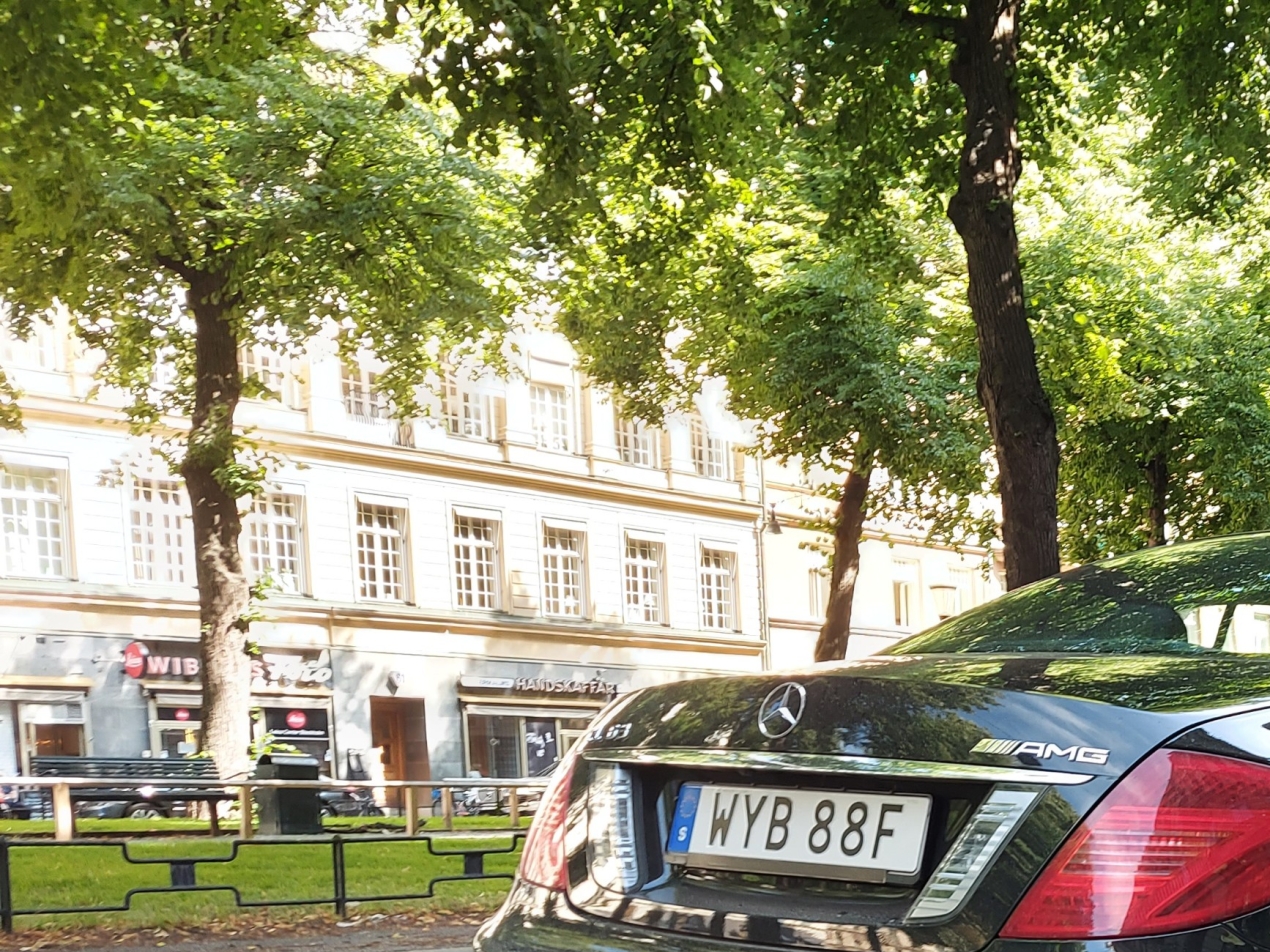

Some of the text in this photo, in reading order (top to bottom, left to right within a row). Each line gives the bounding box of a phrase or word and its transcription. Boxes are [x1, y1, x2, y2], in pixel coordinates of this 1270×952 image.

[1011, 741, 1111, 765] AMG
[677, 826, 689, 842] S
[709, 792, 904, 859] WYB 88F
